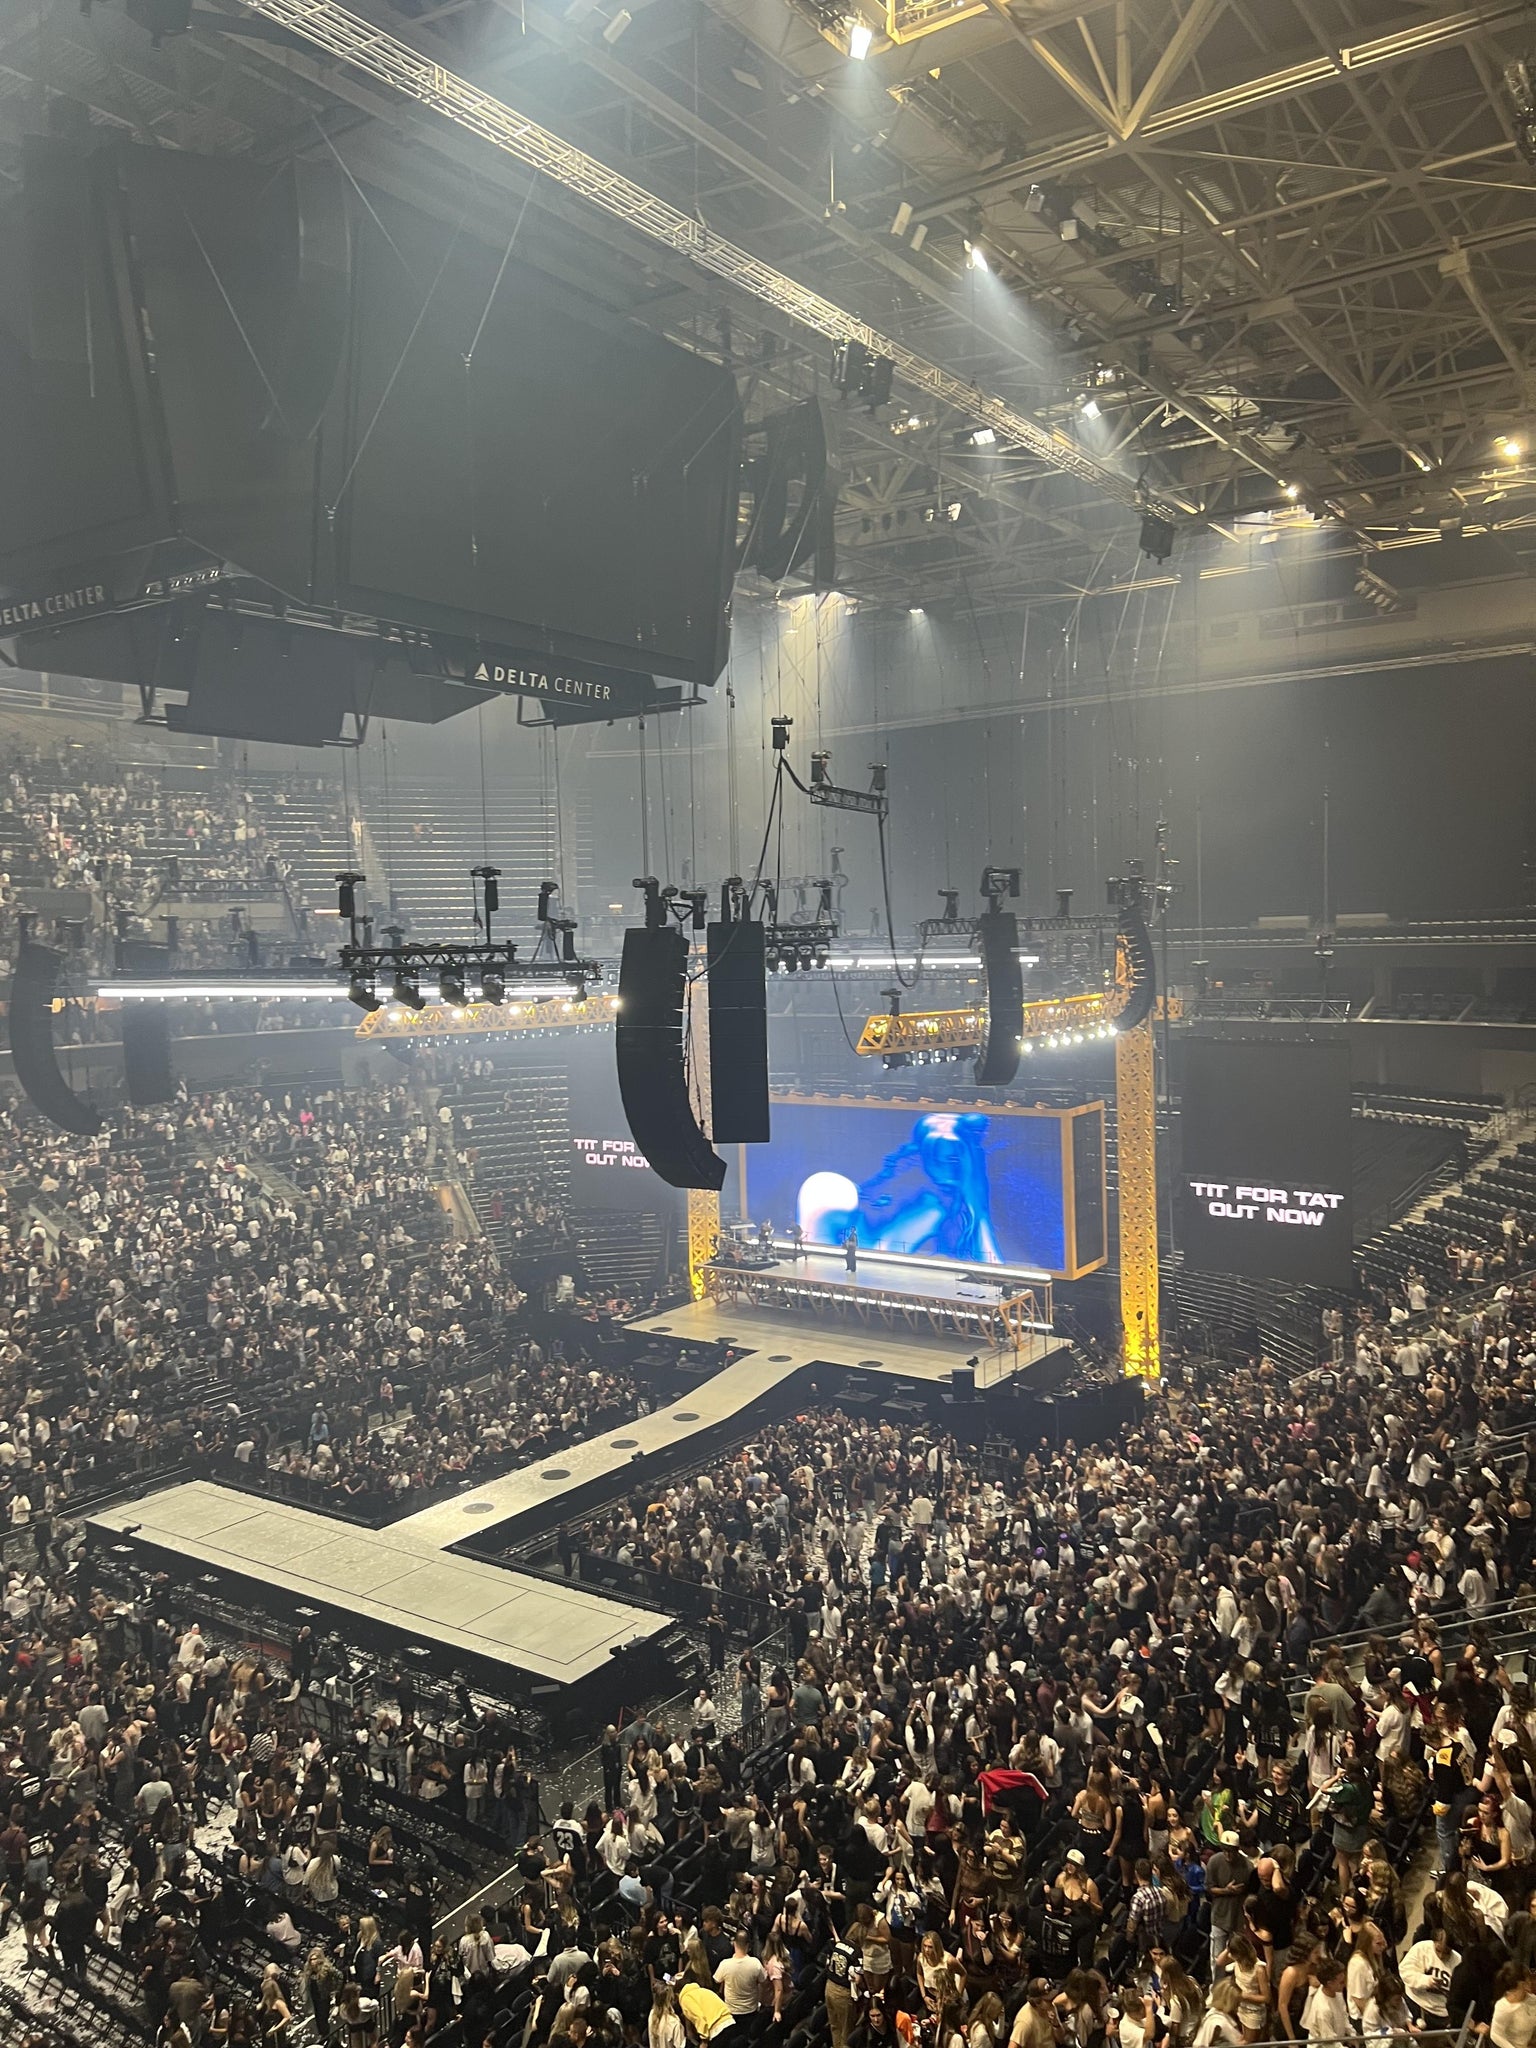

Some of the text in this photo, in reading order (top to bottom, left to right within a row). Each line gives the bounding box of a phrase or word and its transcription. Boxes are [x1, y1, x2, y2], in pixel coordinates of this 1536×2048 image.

[0, 585, 104, 626] ELTA CENTER
[494, 666, 611, 701] DELTA CENTER
[574, 1139, 635, 1152] TIT FOR
[585, 1153, 617, 1165] OUT
[1190, 1182, 1344, 1208] TIT FOR TAT
[1209, 1202, 1325, 1226] OUT NOW
[556, 1831, 574, 1850] 23
